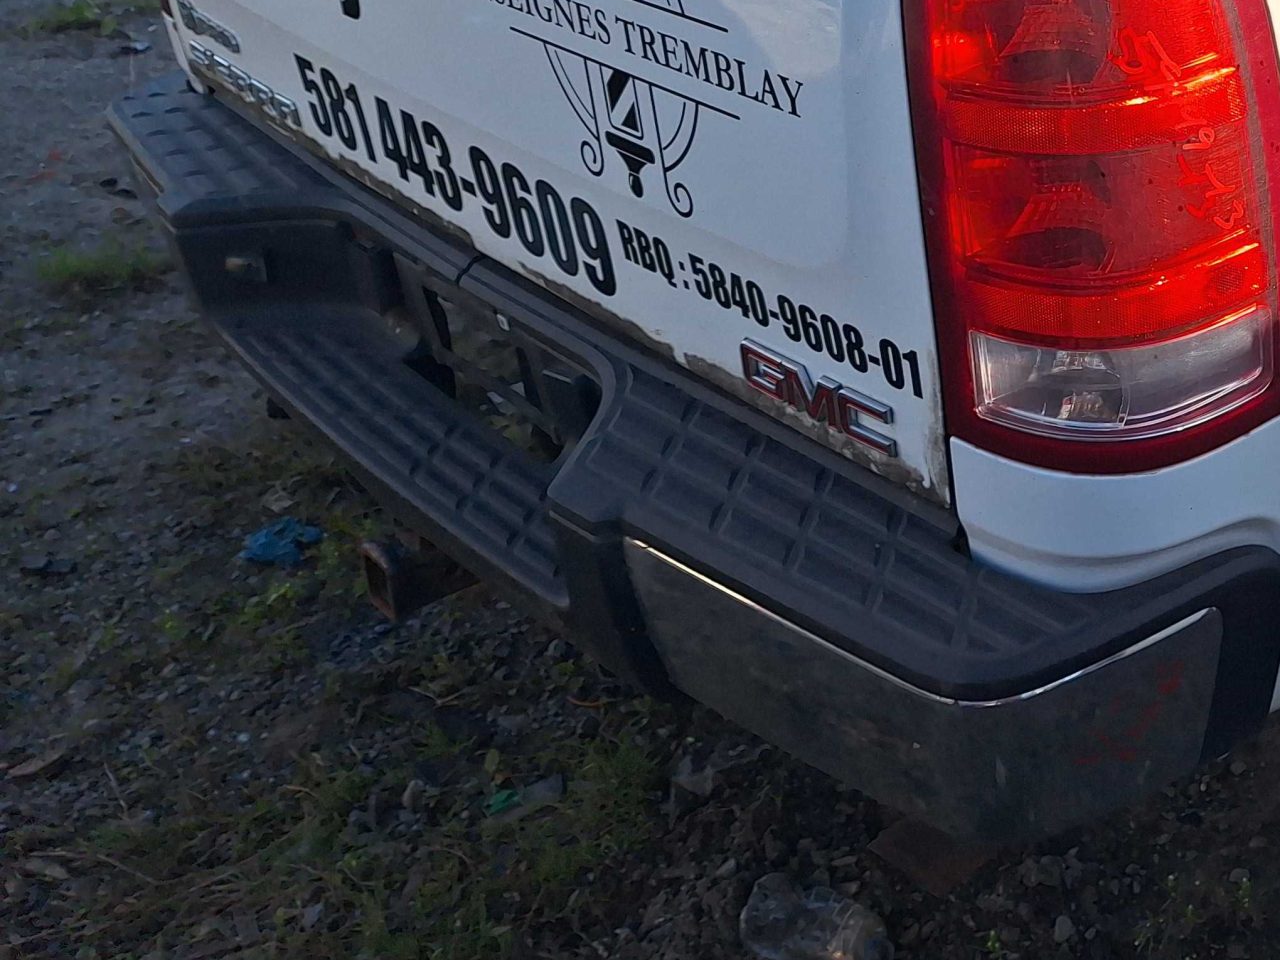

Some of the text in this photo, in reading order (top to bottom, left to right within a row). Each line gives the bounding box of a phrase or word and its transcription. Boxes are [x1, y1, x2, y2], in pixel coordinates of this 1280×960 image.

[614, 16, 804, 119] TREMBLAY
[688, 252, 924, 400] 5840-9608-01
[740, 337, 898, 458] GMC
